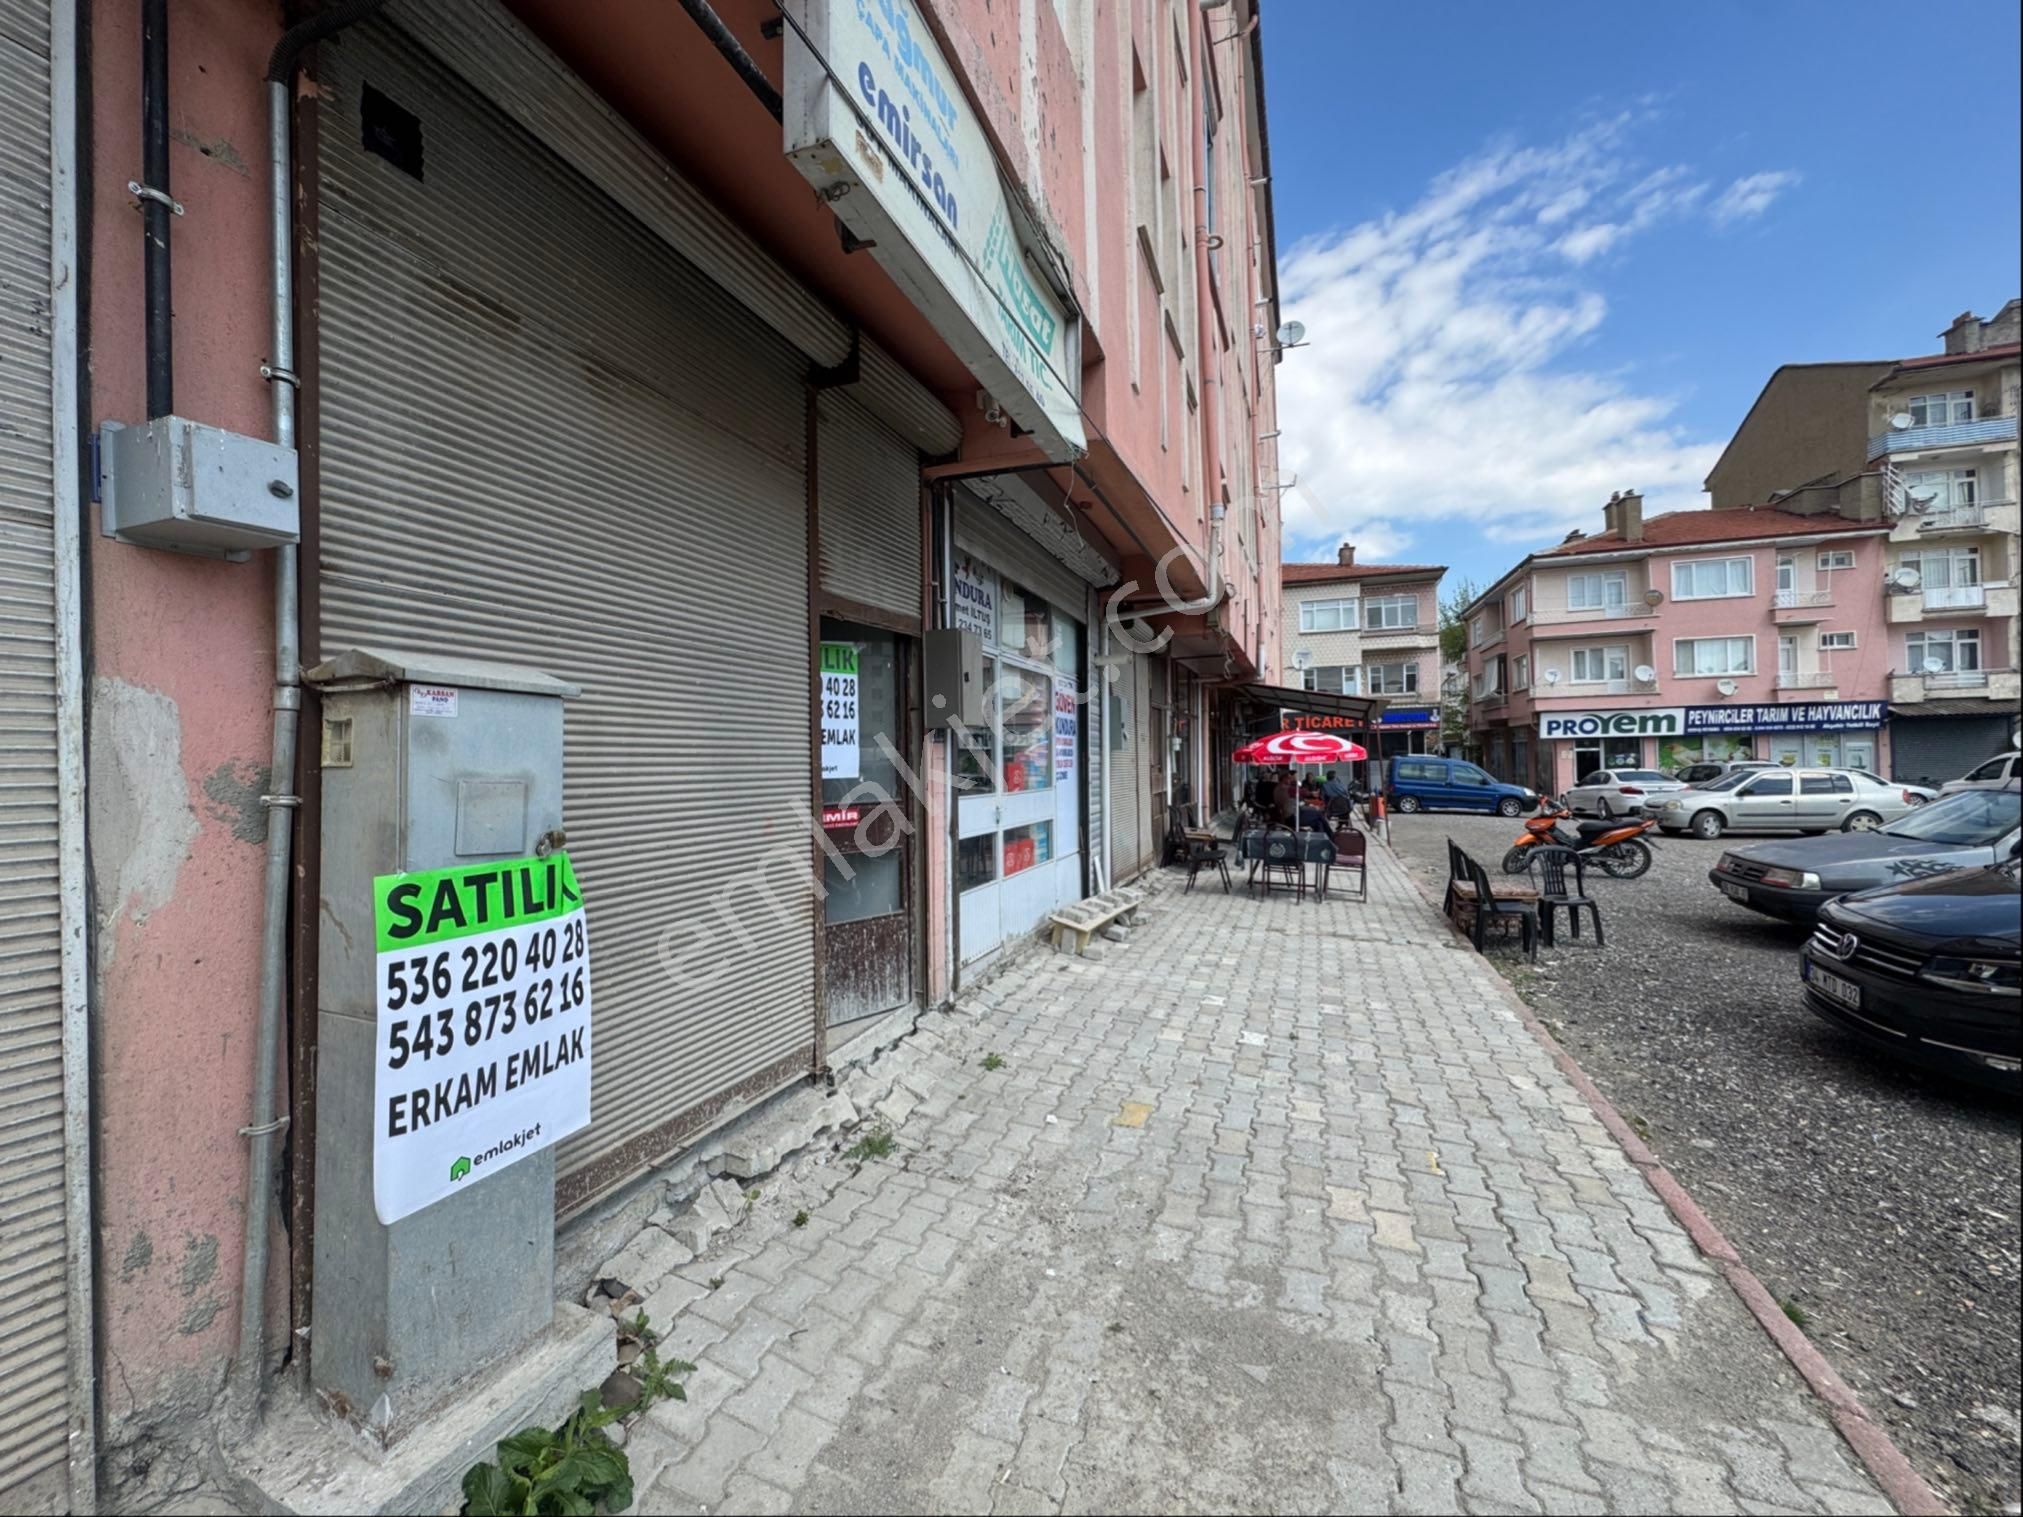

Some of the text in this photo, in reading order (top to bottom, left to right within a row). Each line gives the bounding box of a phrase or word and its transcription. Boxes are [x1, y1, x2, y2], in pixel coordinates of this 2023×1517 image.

[858, 61, 958, 231] emirsan
[826, 677, 856, 697] 40 28
[827, 700, 855, 719] 62 16
[1756, 706, 1788, 723] TARIM
[1791, 706, 1806, 721] VE
[1808, 704, 1881, 721] HAYVANCILIK
[387, 864, 578, 938] SATILI
[387, 918, 584, 1010] 536 220 40 28
[388, 966, 584, 1070] 543 873 62 16
[388, 1026, 584, 1138] ERKAM EMLAK
[473, 1123, 541, 1168] emlakjet
